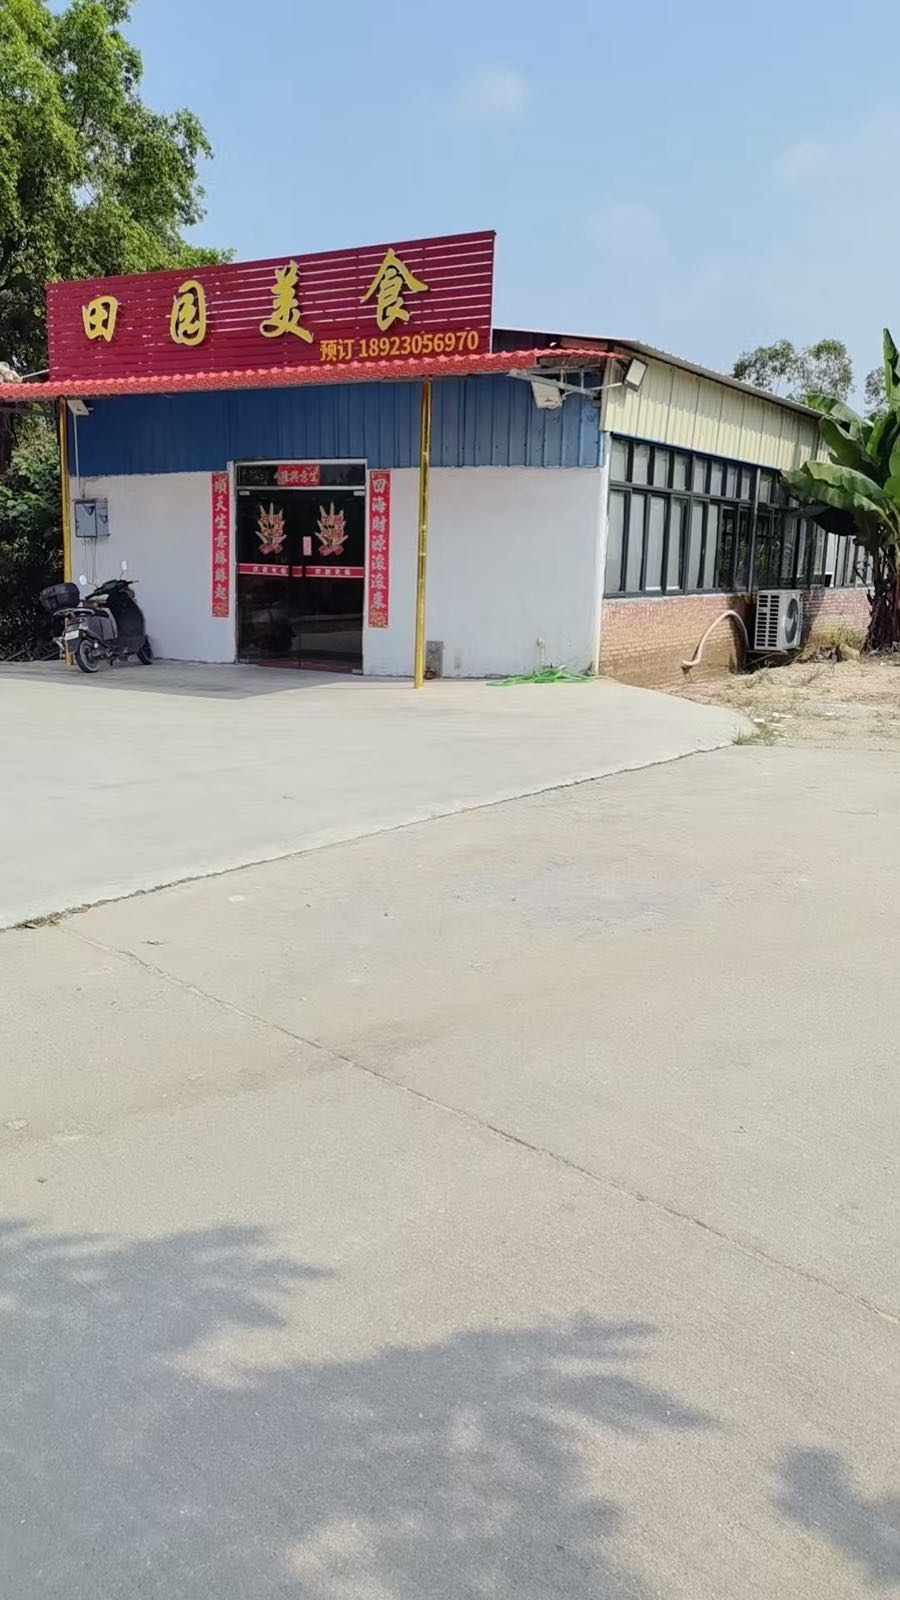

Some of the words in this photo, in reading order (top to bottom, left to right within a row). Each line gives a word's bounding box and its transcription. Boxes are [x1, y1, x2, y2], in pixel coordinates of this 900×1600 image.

[81, 247, 429, 346] 田园美食
[319, 339, 355, 362] 预订
[358, 330, 480, 358] 18923056970
